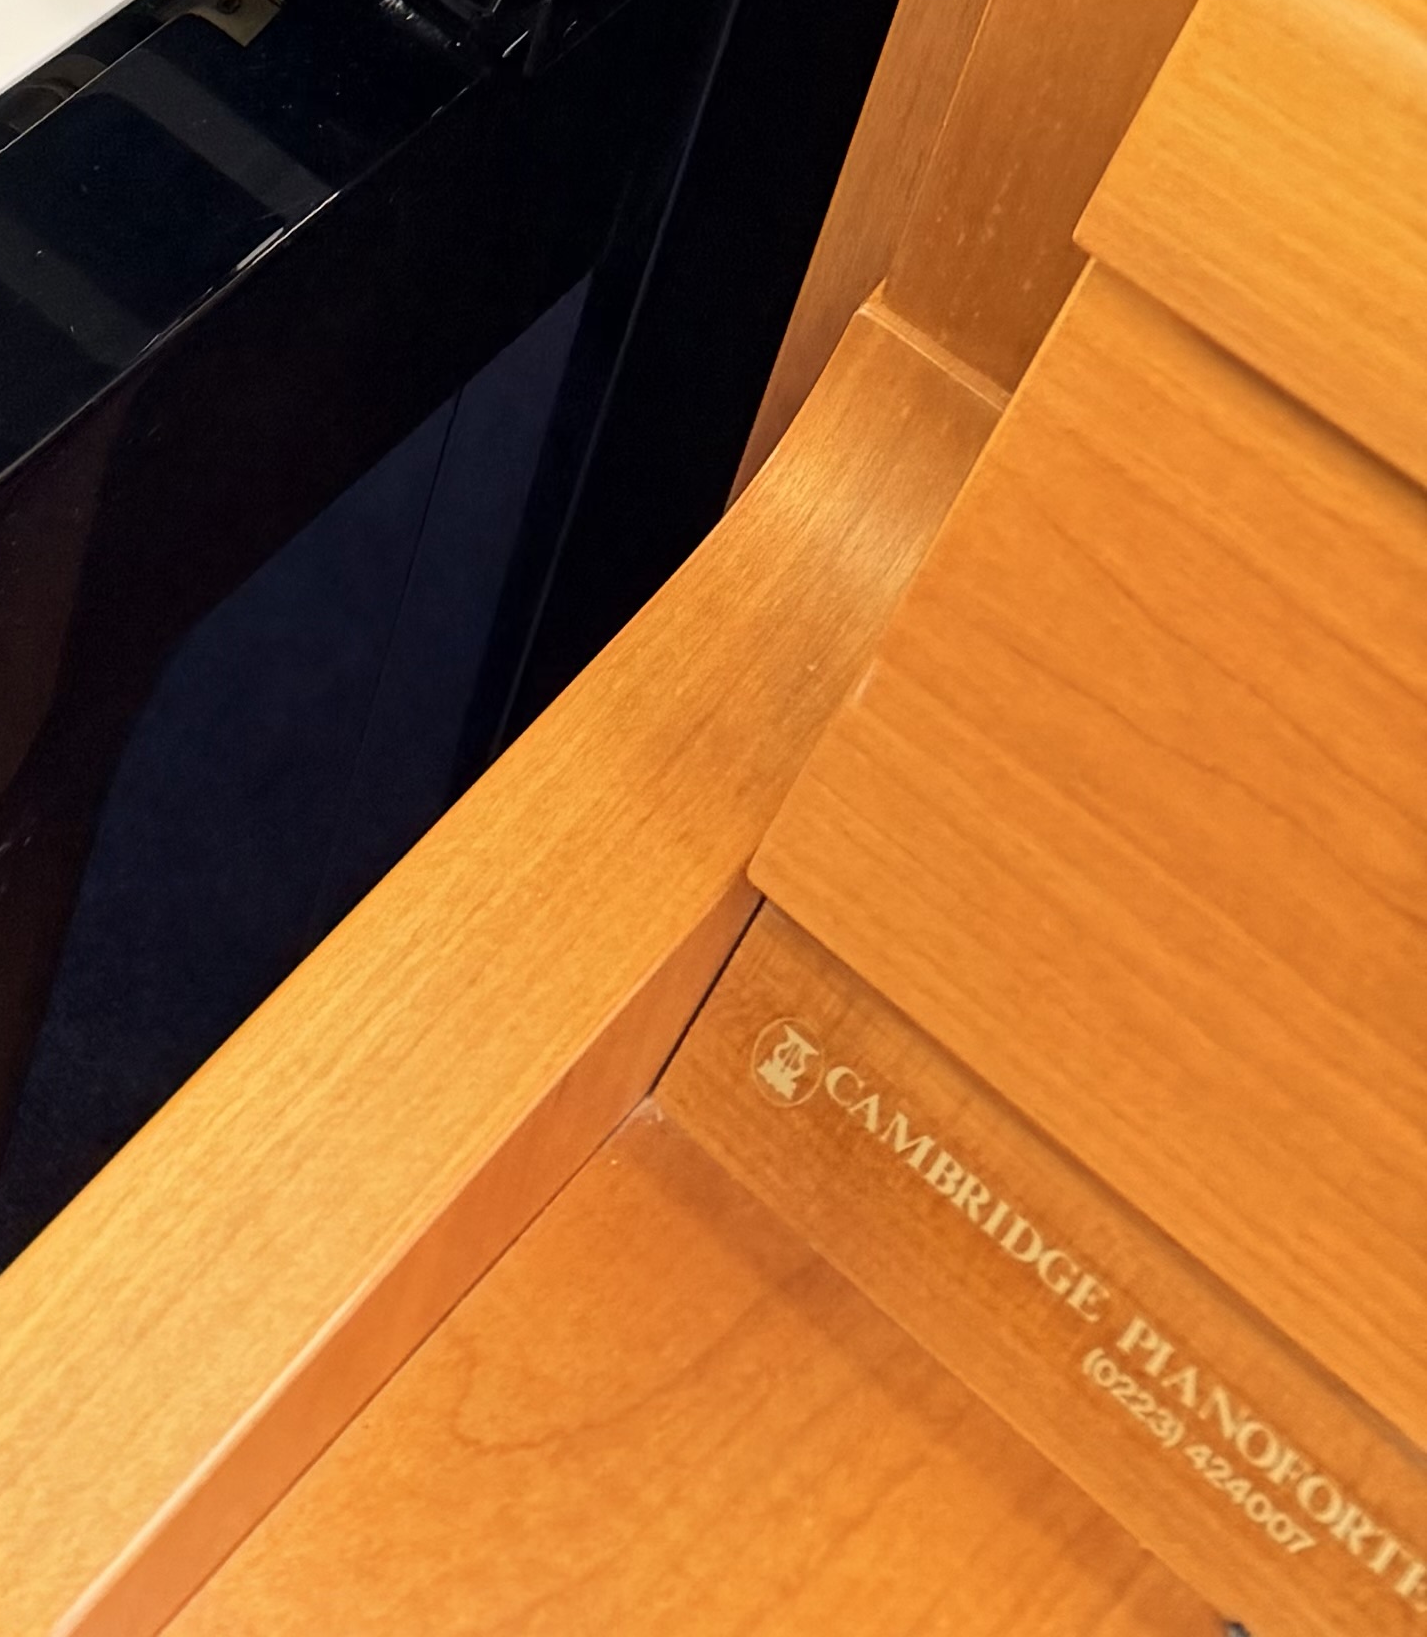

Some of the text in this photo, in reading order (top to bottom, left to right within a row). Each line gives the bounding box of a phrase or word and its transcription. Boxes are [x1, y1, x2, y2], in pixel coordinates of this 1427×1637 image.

[824, 1065, 1112, 1322] CAMBRIDGE
[1082, 1347, 1315, 1555] (0223) 424007
